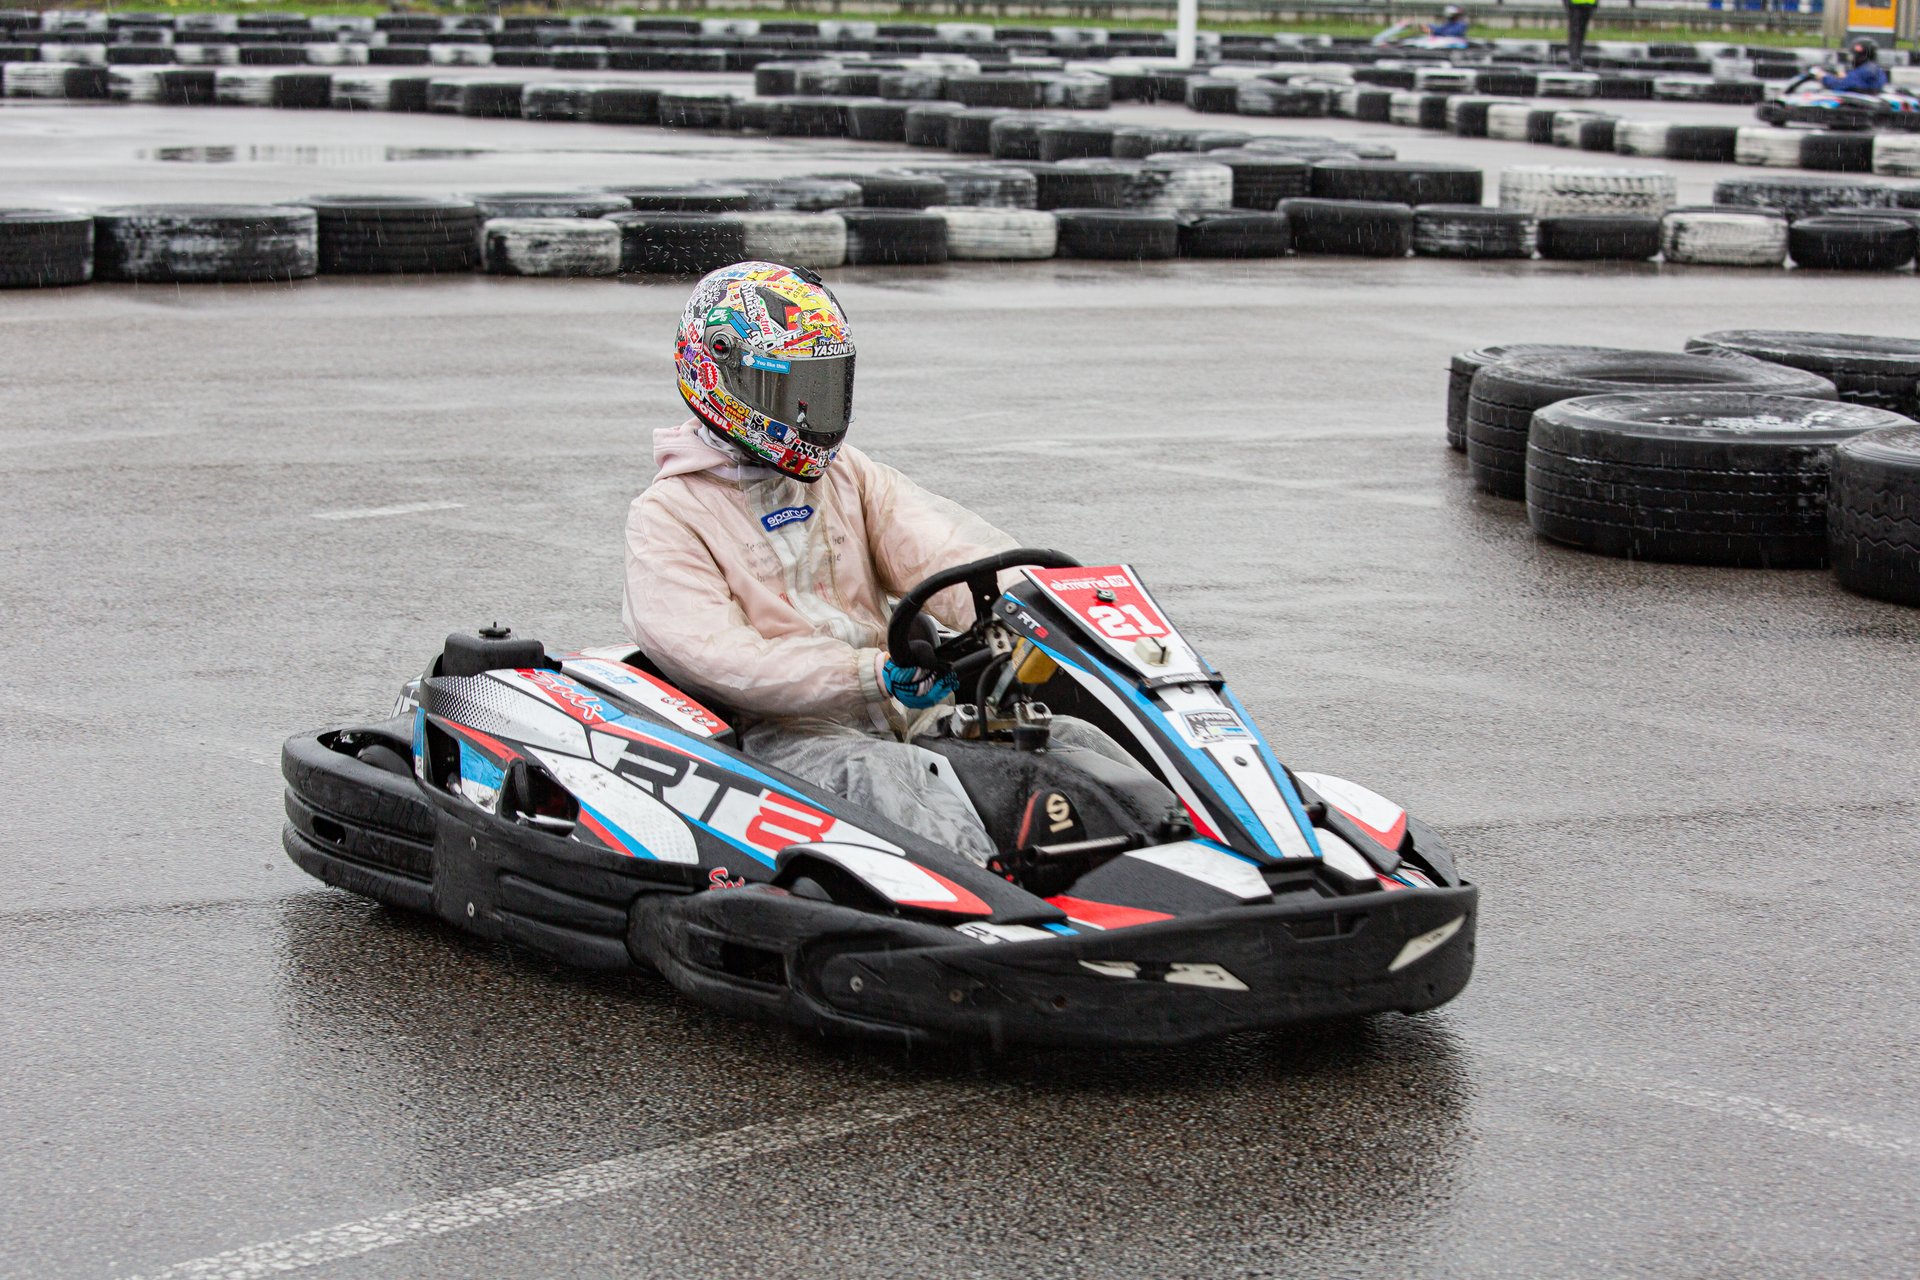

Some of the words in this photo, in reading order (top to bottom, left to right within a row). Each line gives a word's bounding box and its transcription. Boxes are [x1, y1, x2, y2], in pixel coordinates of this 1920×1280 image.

[690, 394, 729, 430] MOTUL
[724, 395, 751, 419] COOL
[767, 508, 811, 527] sparco
[1017, 611, 1049, 639] RT8
[1087, 603, 1166, 637] 21
[518, 671, 604, 720] Sodi
[612, 739, 837, 852] RT8
